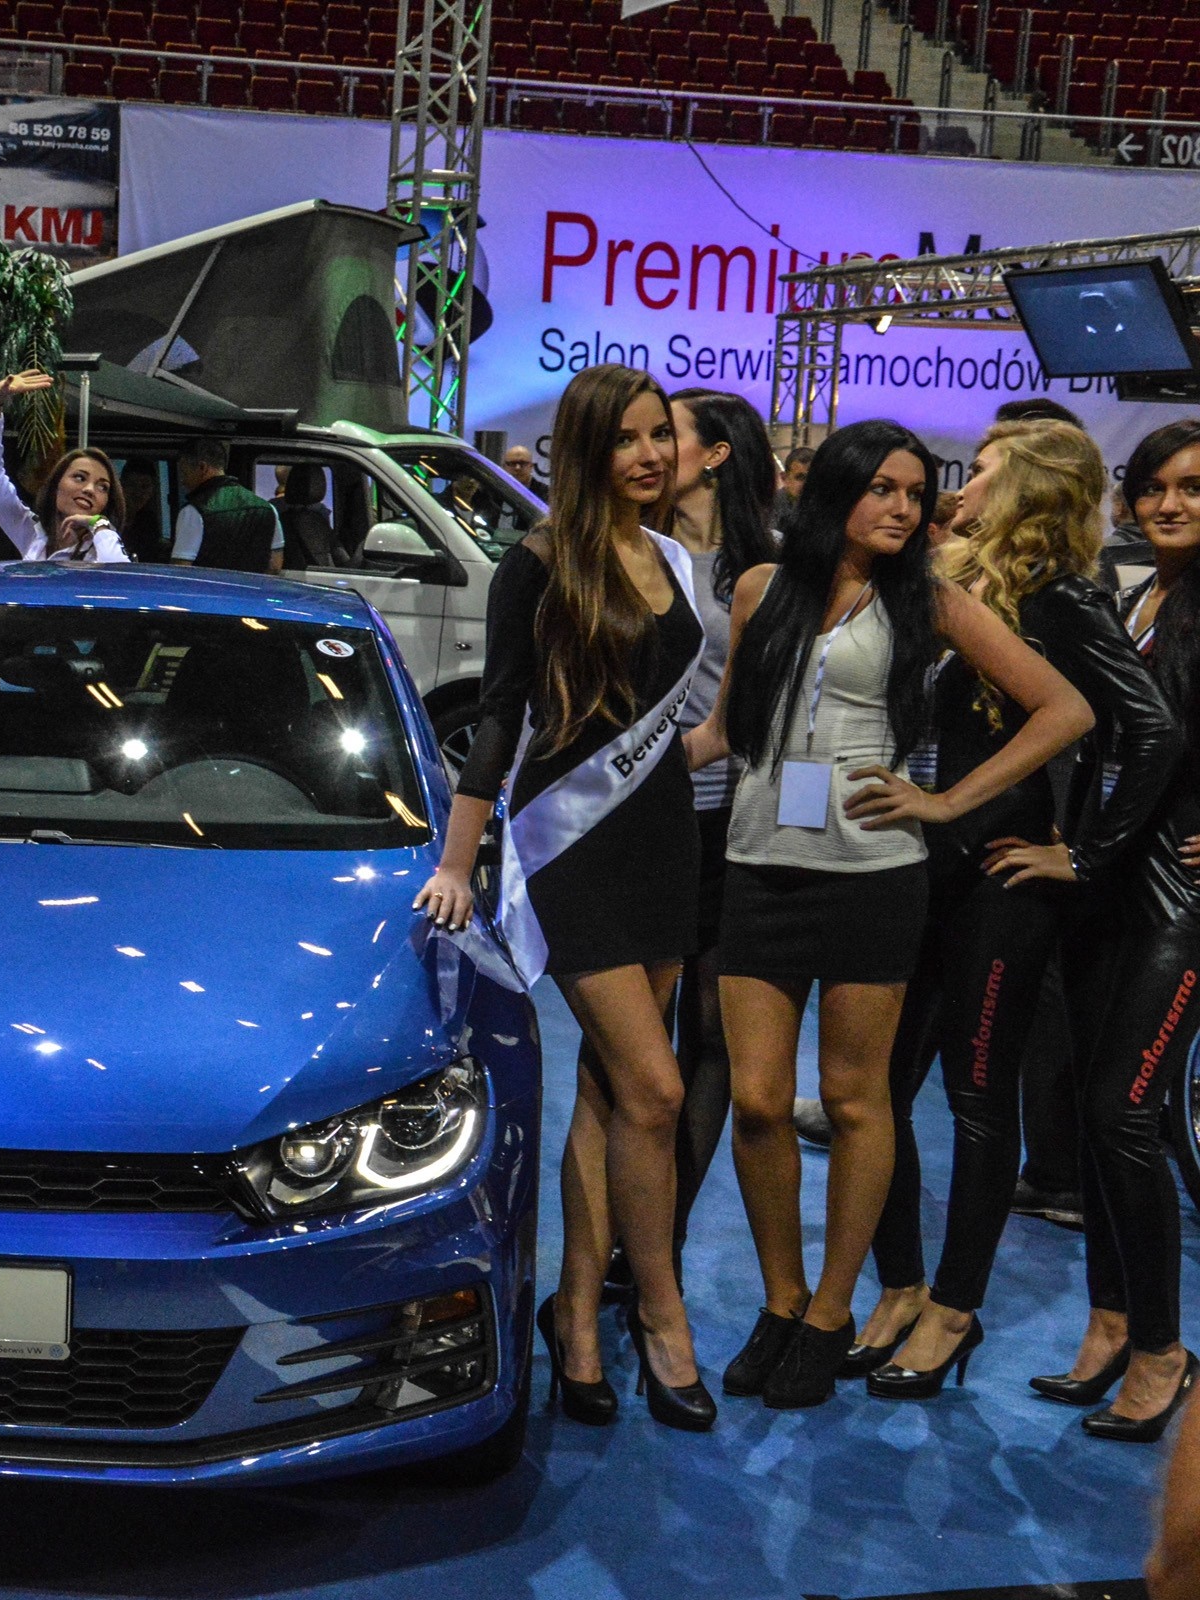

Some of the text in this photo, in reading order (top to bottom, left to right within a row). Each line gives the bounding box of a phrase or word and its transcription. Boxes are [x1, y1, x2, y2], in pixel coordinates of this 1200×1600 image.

[8, 122, 111, 141] 58 520 78 59
[3, 204, 105, 246] KMJ
[538, 327, 650, 374] Salon
[665, 334, 793, 383] Serwis
[1128, 969, 1198, 1104] motorismo
[27, 1347, 44, 1355] VW
